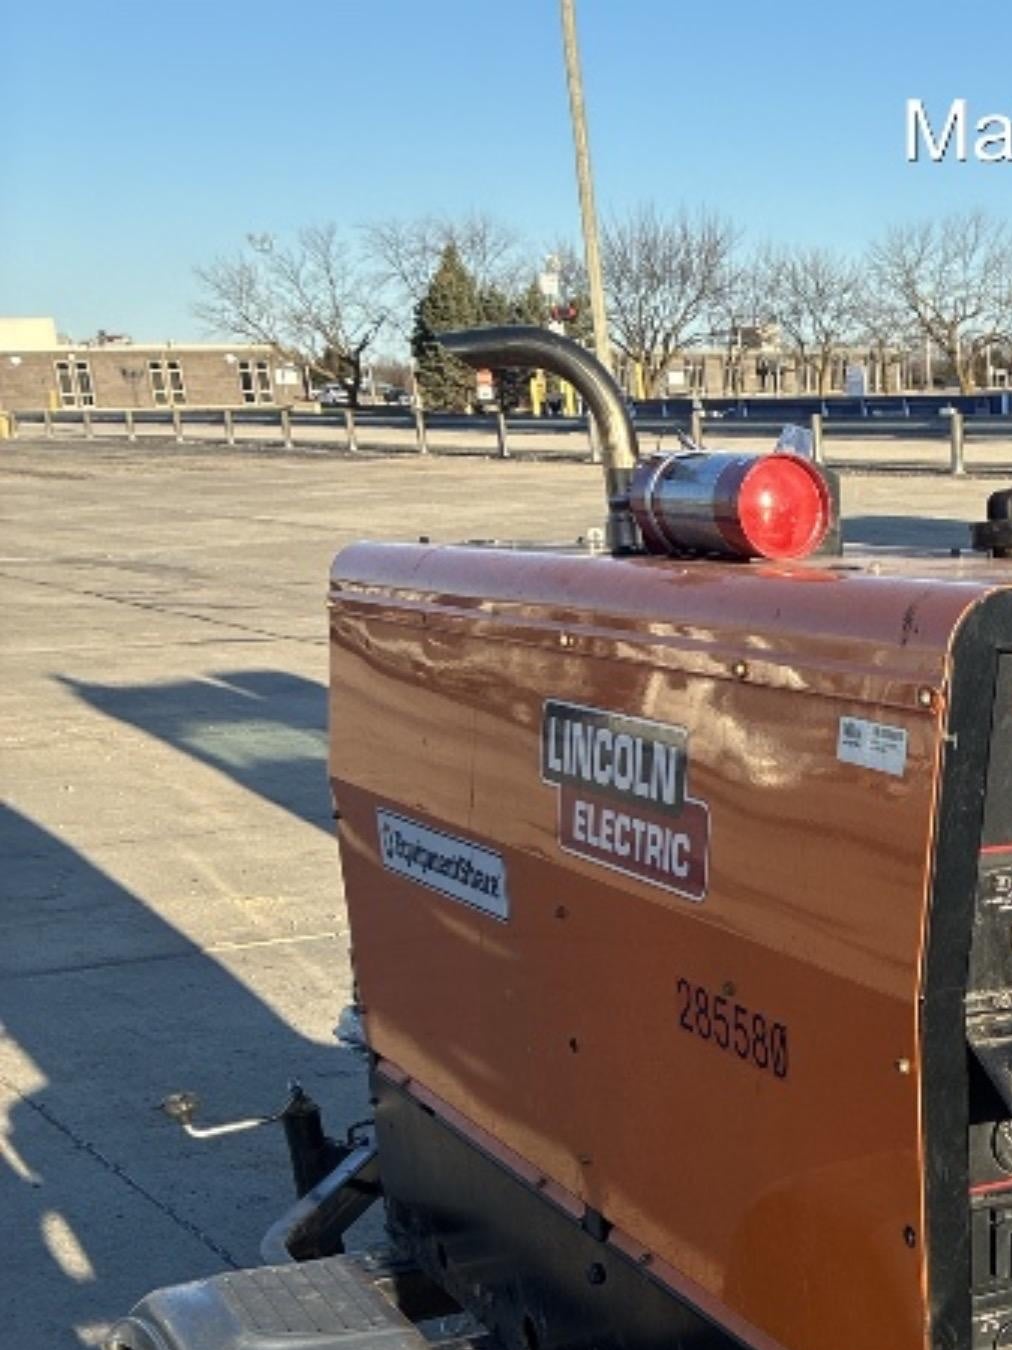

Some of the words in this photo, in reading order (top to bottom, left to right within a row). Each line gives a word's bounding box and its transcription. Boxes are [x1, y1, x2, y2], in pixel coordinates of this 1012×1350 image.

[548, 716, 678, 805] LINCOLN
[572, 800, 690, 878] ELECTRIC
[677, 978, 787, 1078] 285580
